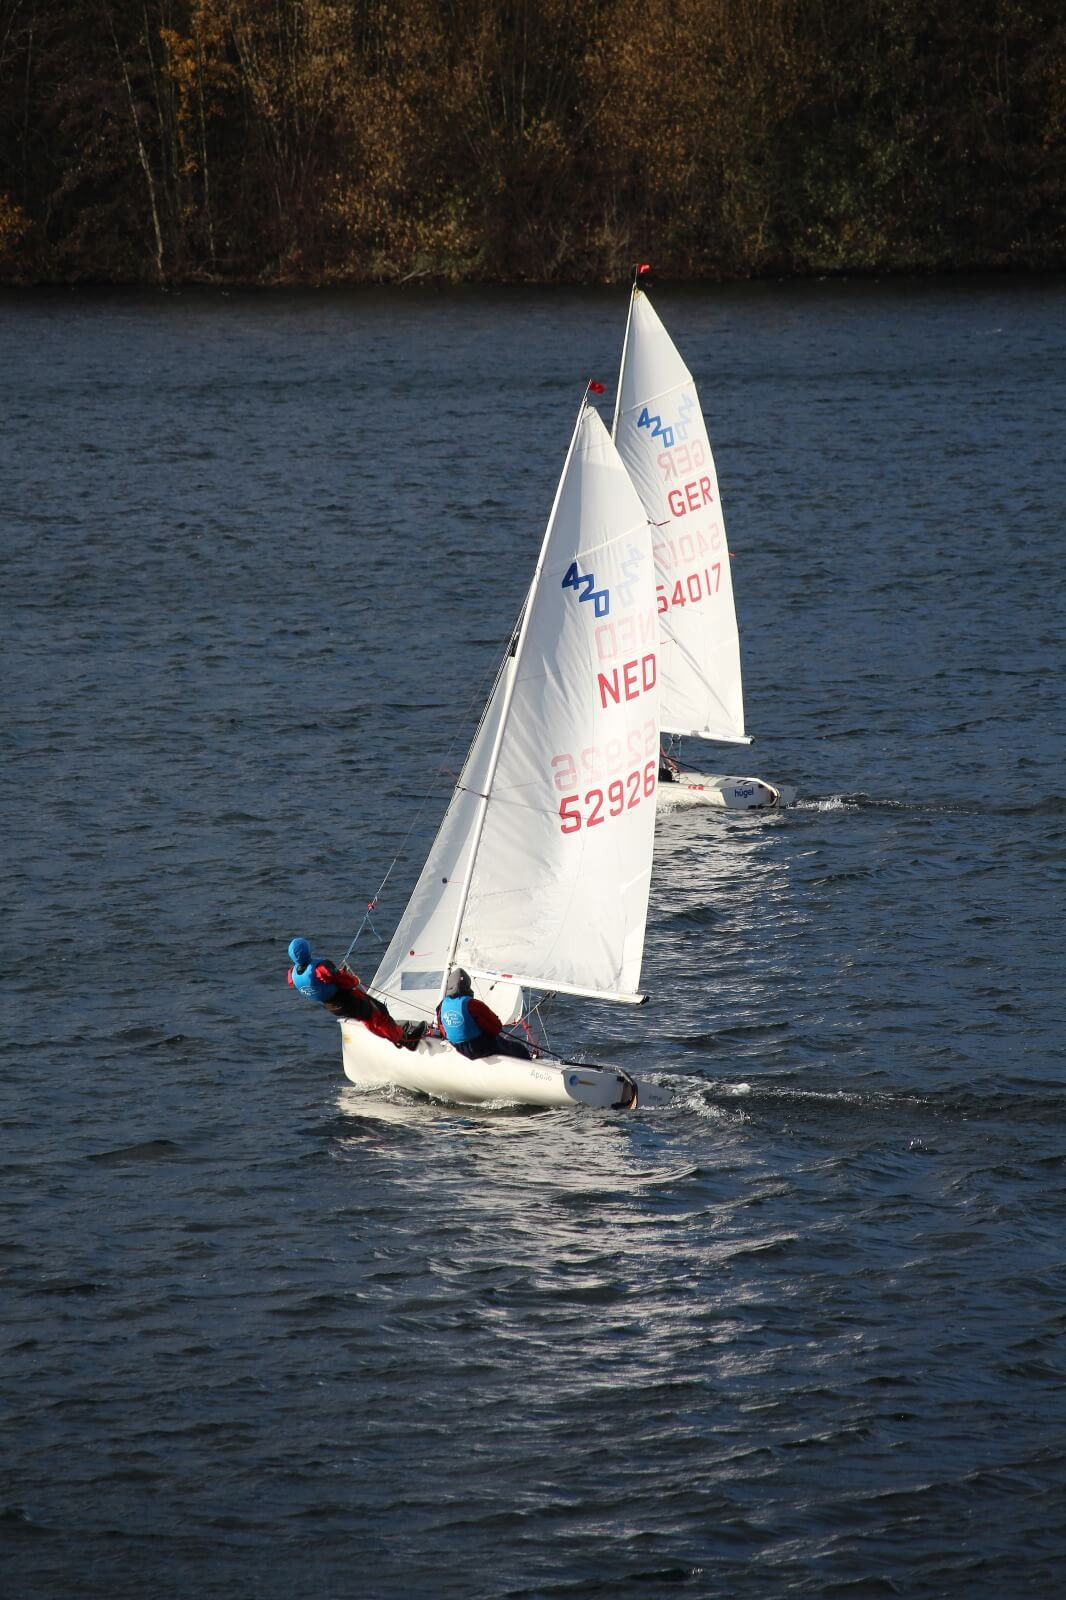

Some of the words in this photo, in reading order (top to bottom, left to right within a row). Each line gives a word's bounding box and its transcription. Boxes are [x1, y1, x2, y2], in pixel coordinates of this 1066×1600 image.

[637, 407, 675, 448] 420
[667, 476, 713, 517] GER
[561, 562, 610, 618] 420
[656, 562, 721, 613] 54017
[598, 653, 657, 709] NED
[559, 760, 656, 834] 52926
[734, 787, 754, 798] hügel
[530, 1069, 553, 1081] Apollo
